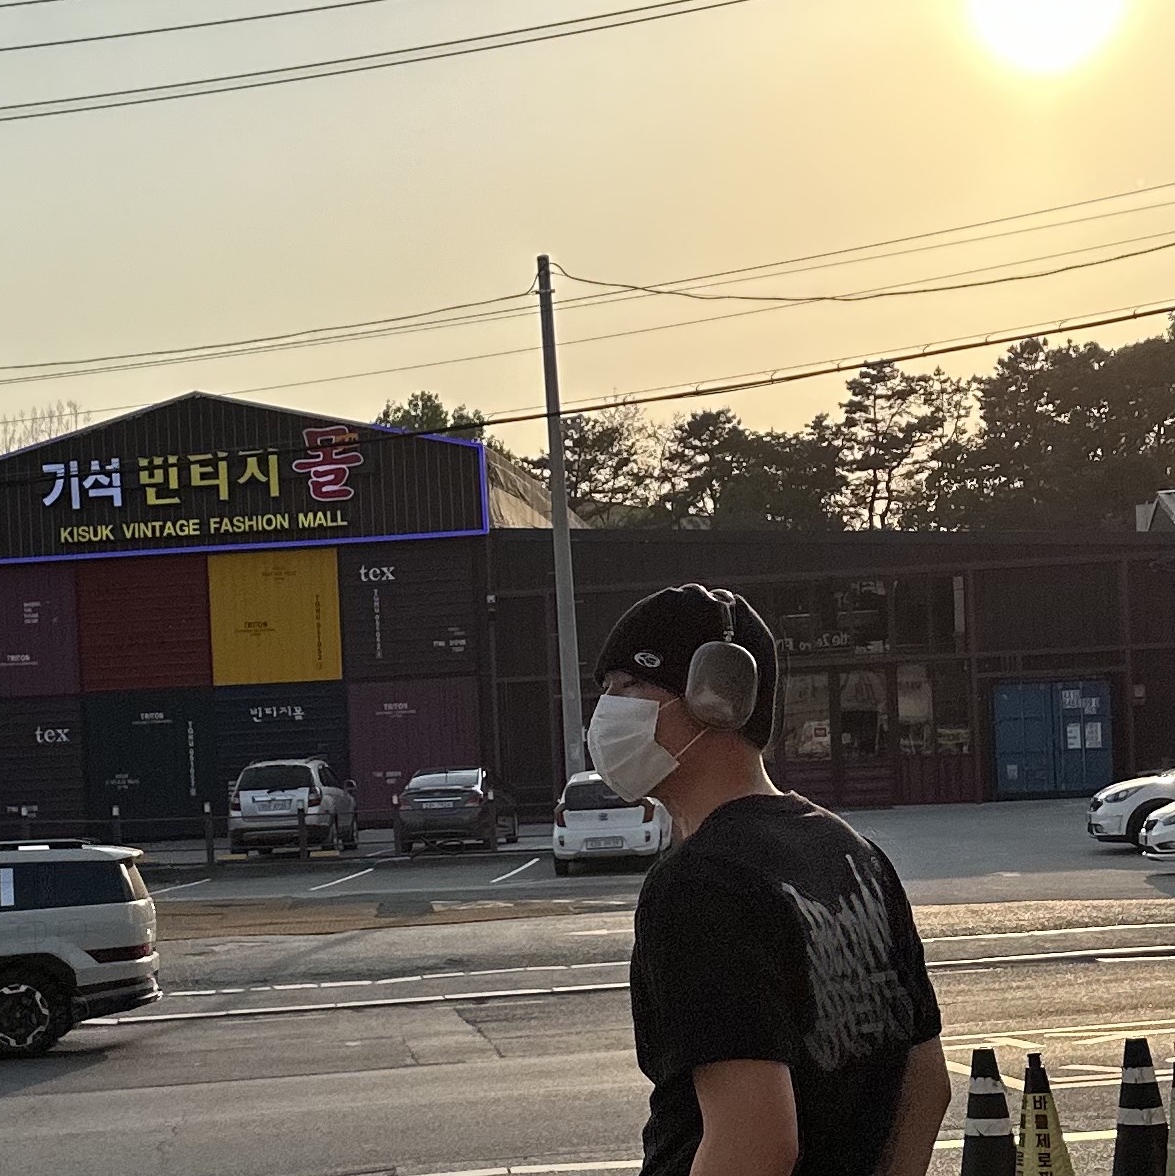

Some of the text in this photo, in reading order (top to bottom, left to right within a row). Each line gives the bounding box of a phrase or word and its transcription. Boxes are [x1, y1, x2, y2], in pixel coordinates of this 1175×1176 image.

[41, 456, 123, 511] 기석
[60, 509, 348, 544] KISUK VINTAGE FASHION MALL
[359, 564, 396, 582] tex
[249, 705, 306, 723] 빈티지몰
[35, 725, 71, 743] tex
